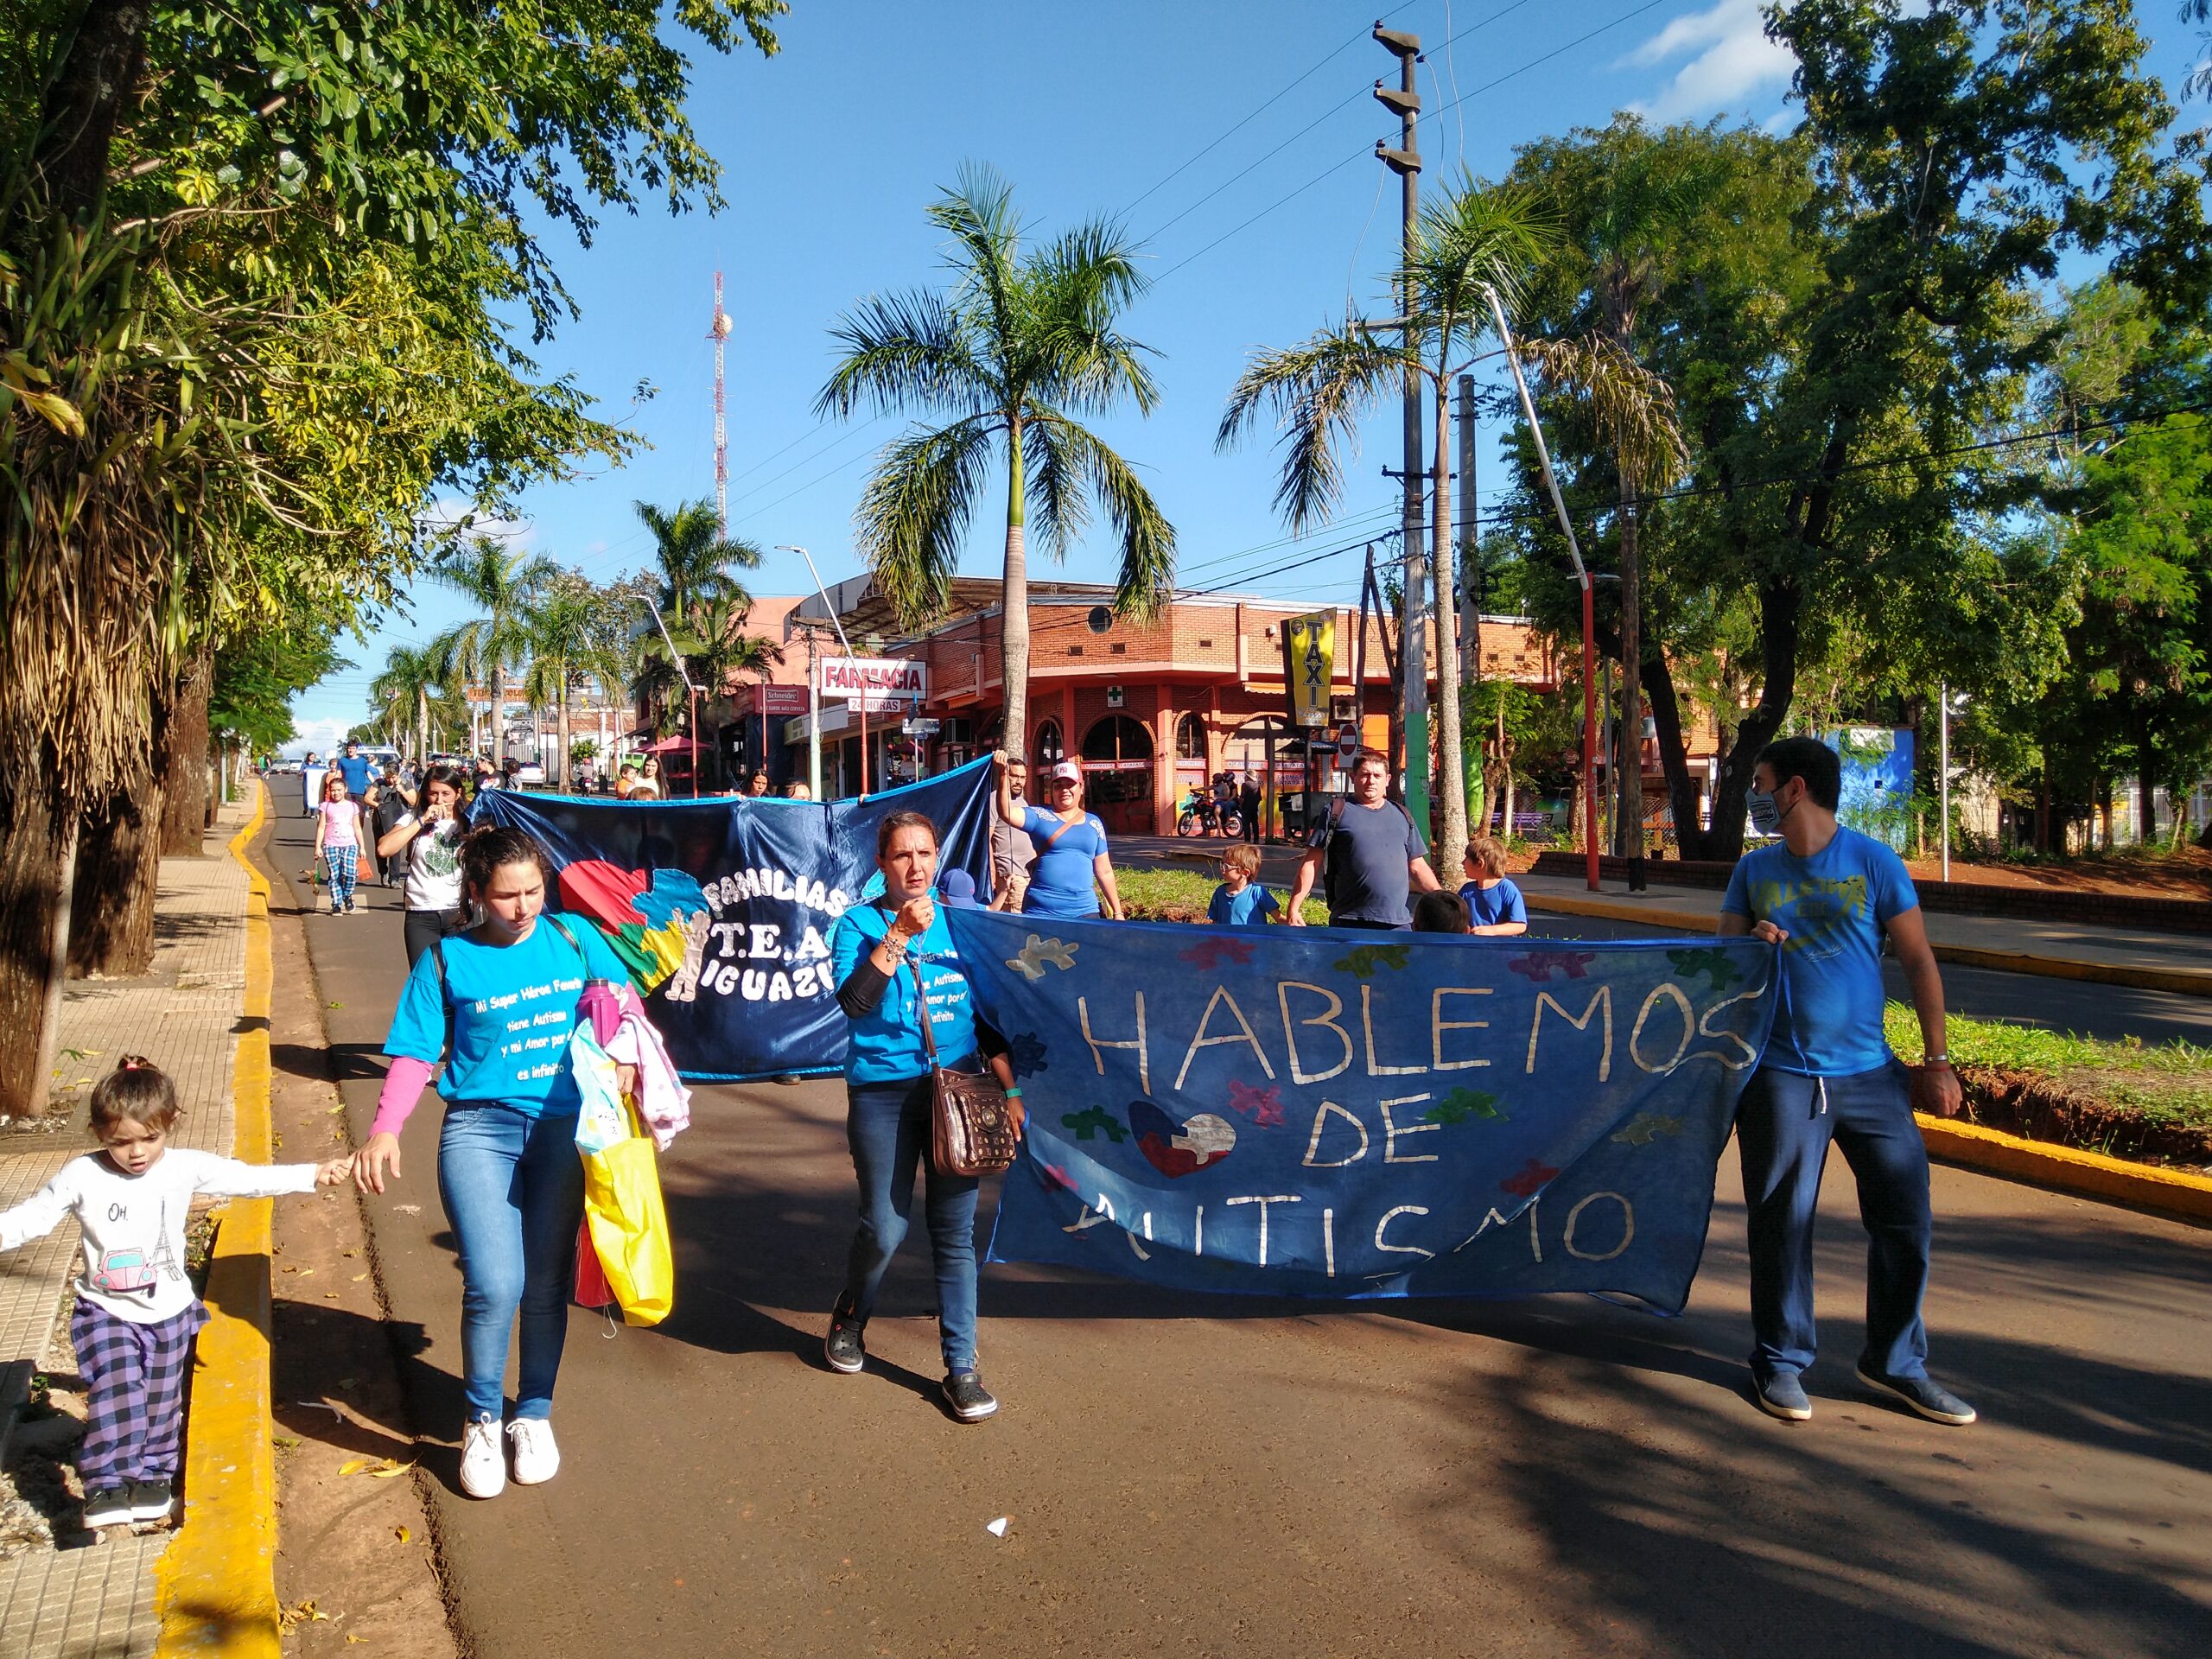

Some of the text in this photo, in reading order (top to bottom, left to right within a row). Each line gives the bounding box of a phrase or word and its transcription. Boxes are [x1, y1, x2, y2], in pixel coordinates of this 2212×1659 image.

[1303, 620, 1325, 707] TAXI
[826, 666, 921, 690] FARMACIA
[767, 691, 797, 700] Schneider
[867, 701, 899, 711] HORAS
[702, 868, 849, 919] FAMILIAS
[933, 973, 964, 988] Autismo
[475, 999, 488, 1014] Mi
[490, 993, 518, 1010] Super
[948, 994, 959, 1007] por
[506, 1010, 567, 1033] tiene Autismo
[931, 1010, 955, 1024] infinito
[500, 1045, 507, 1058] y
[510, 1039, 522, 1053] mi
[524, 1037, 549, 1051] Amor
[550, 1033, 565, 1050] por
[1077, 978, 1767, 1096] HABLEMOS
[517, 1062, 565, 1081] es infinito
[1300, 1091, 1441, 1168] DE
